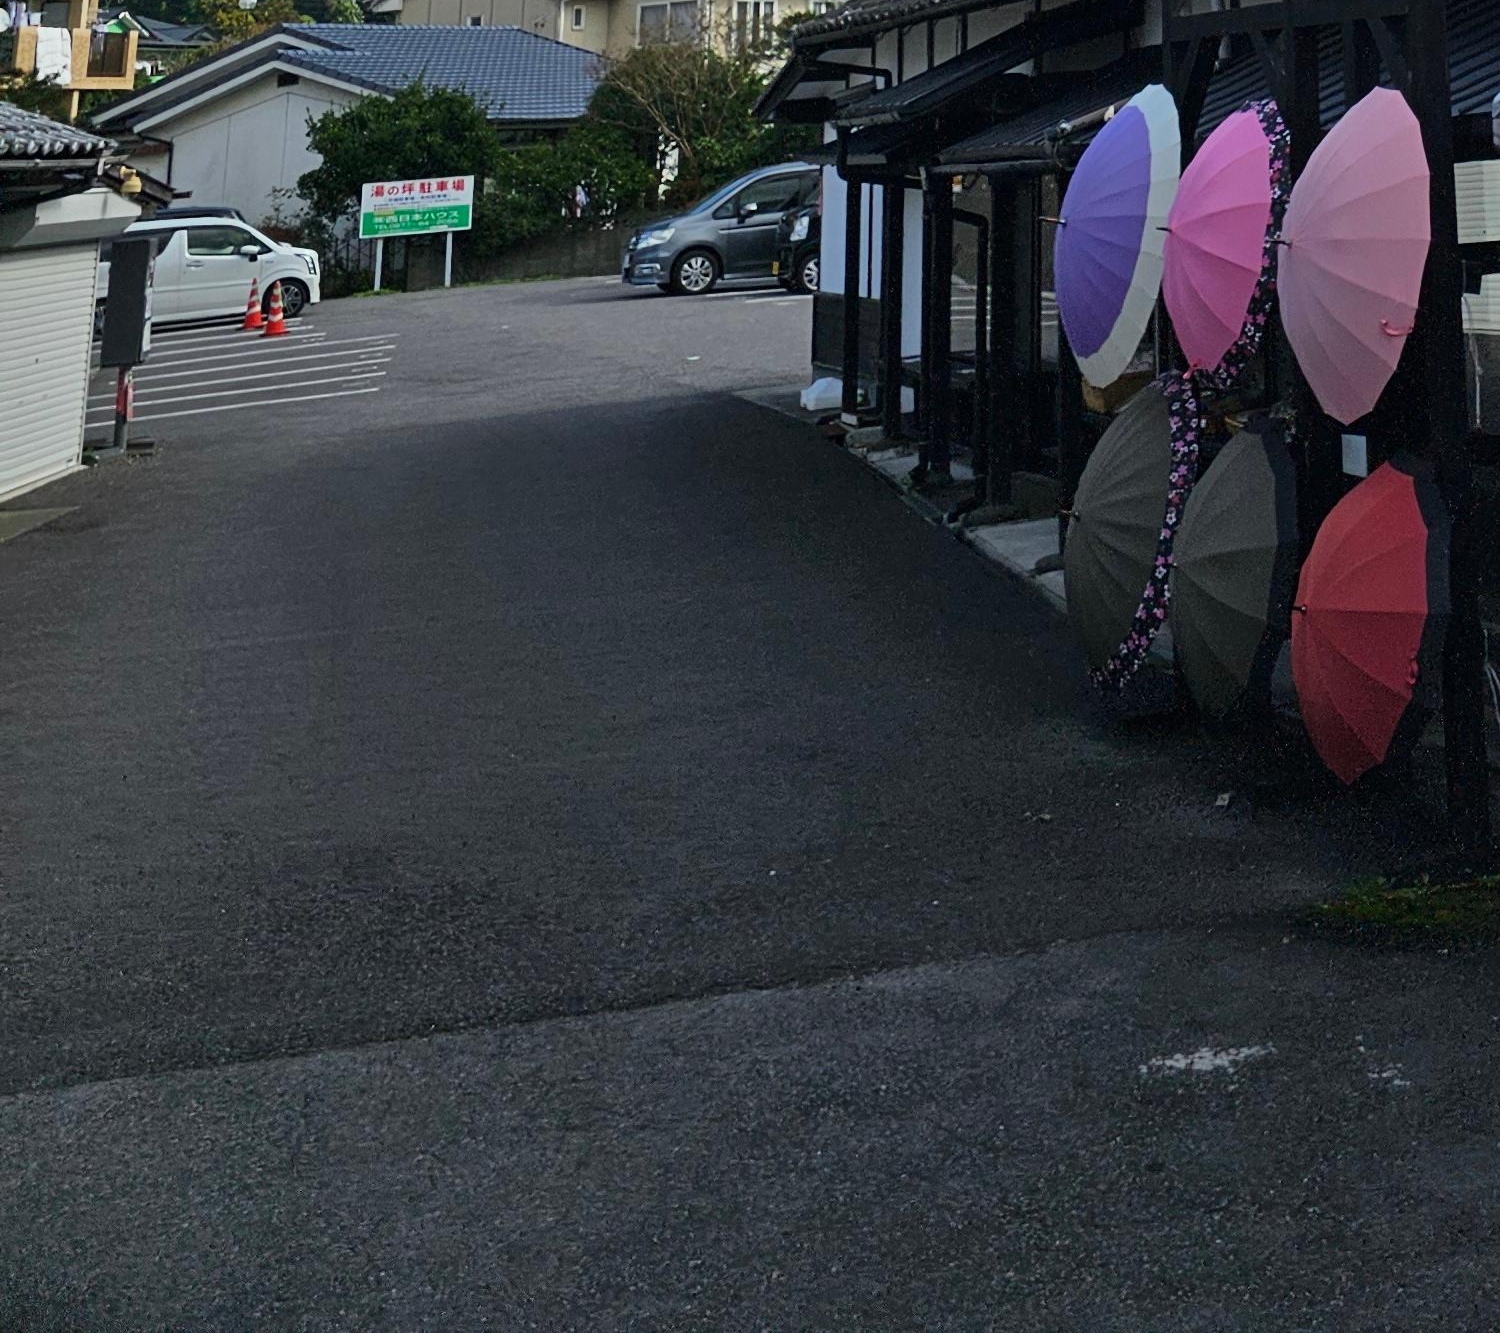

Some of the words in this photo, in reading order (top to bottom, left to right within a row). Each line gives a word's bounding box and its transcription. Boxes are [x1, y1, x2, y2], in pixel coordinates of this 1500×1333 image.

[370, 179, 465, 198] 湯の坪駐車場
